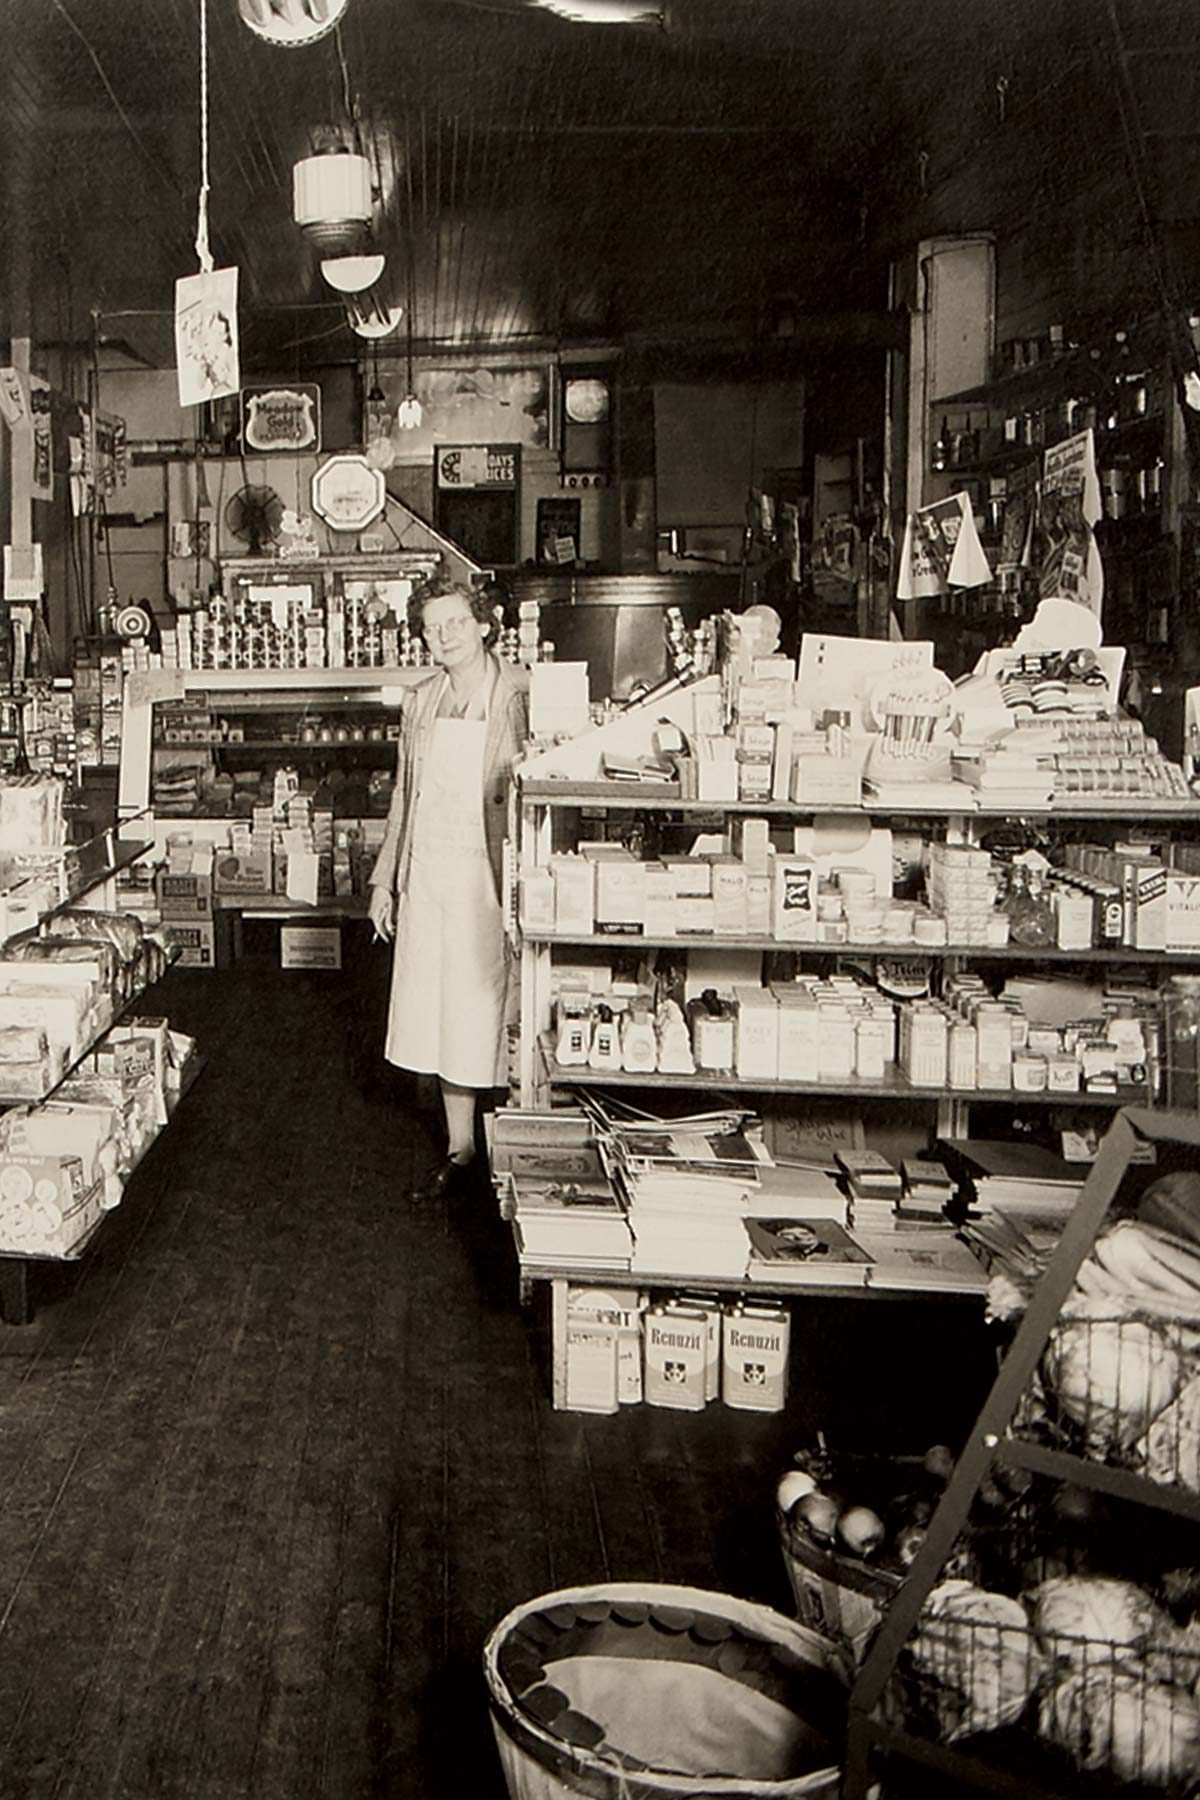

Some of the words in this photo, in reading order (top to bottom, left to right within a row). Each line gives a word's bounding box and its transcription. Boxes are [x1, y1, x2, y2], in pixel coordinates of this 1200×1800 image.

[267, 415, 294, 428] Gold
[651, 1326, 701, 1350] Renuzit
[730, 1329, 781, 1352] Renuzit
